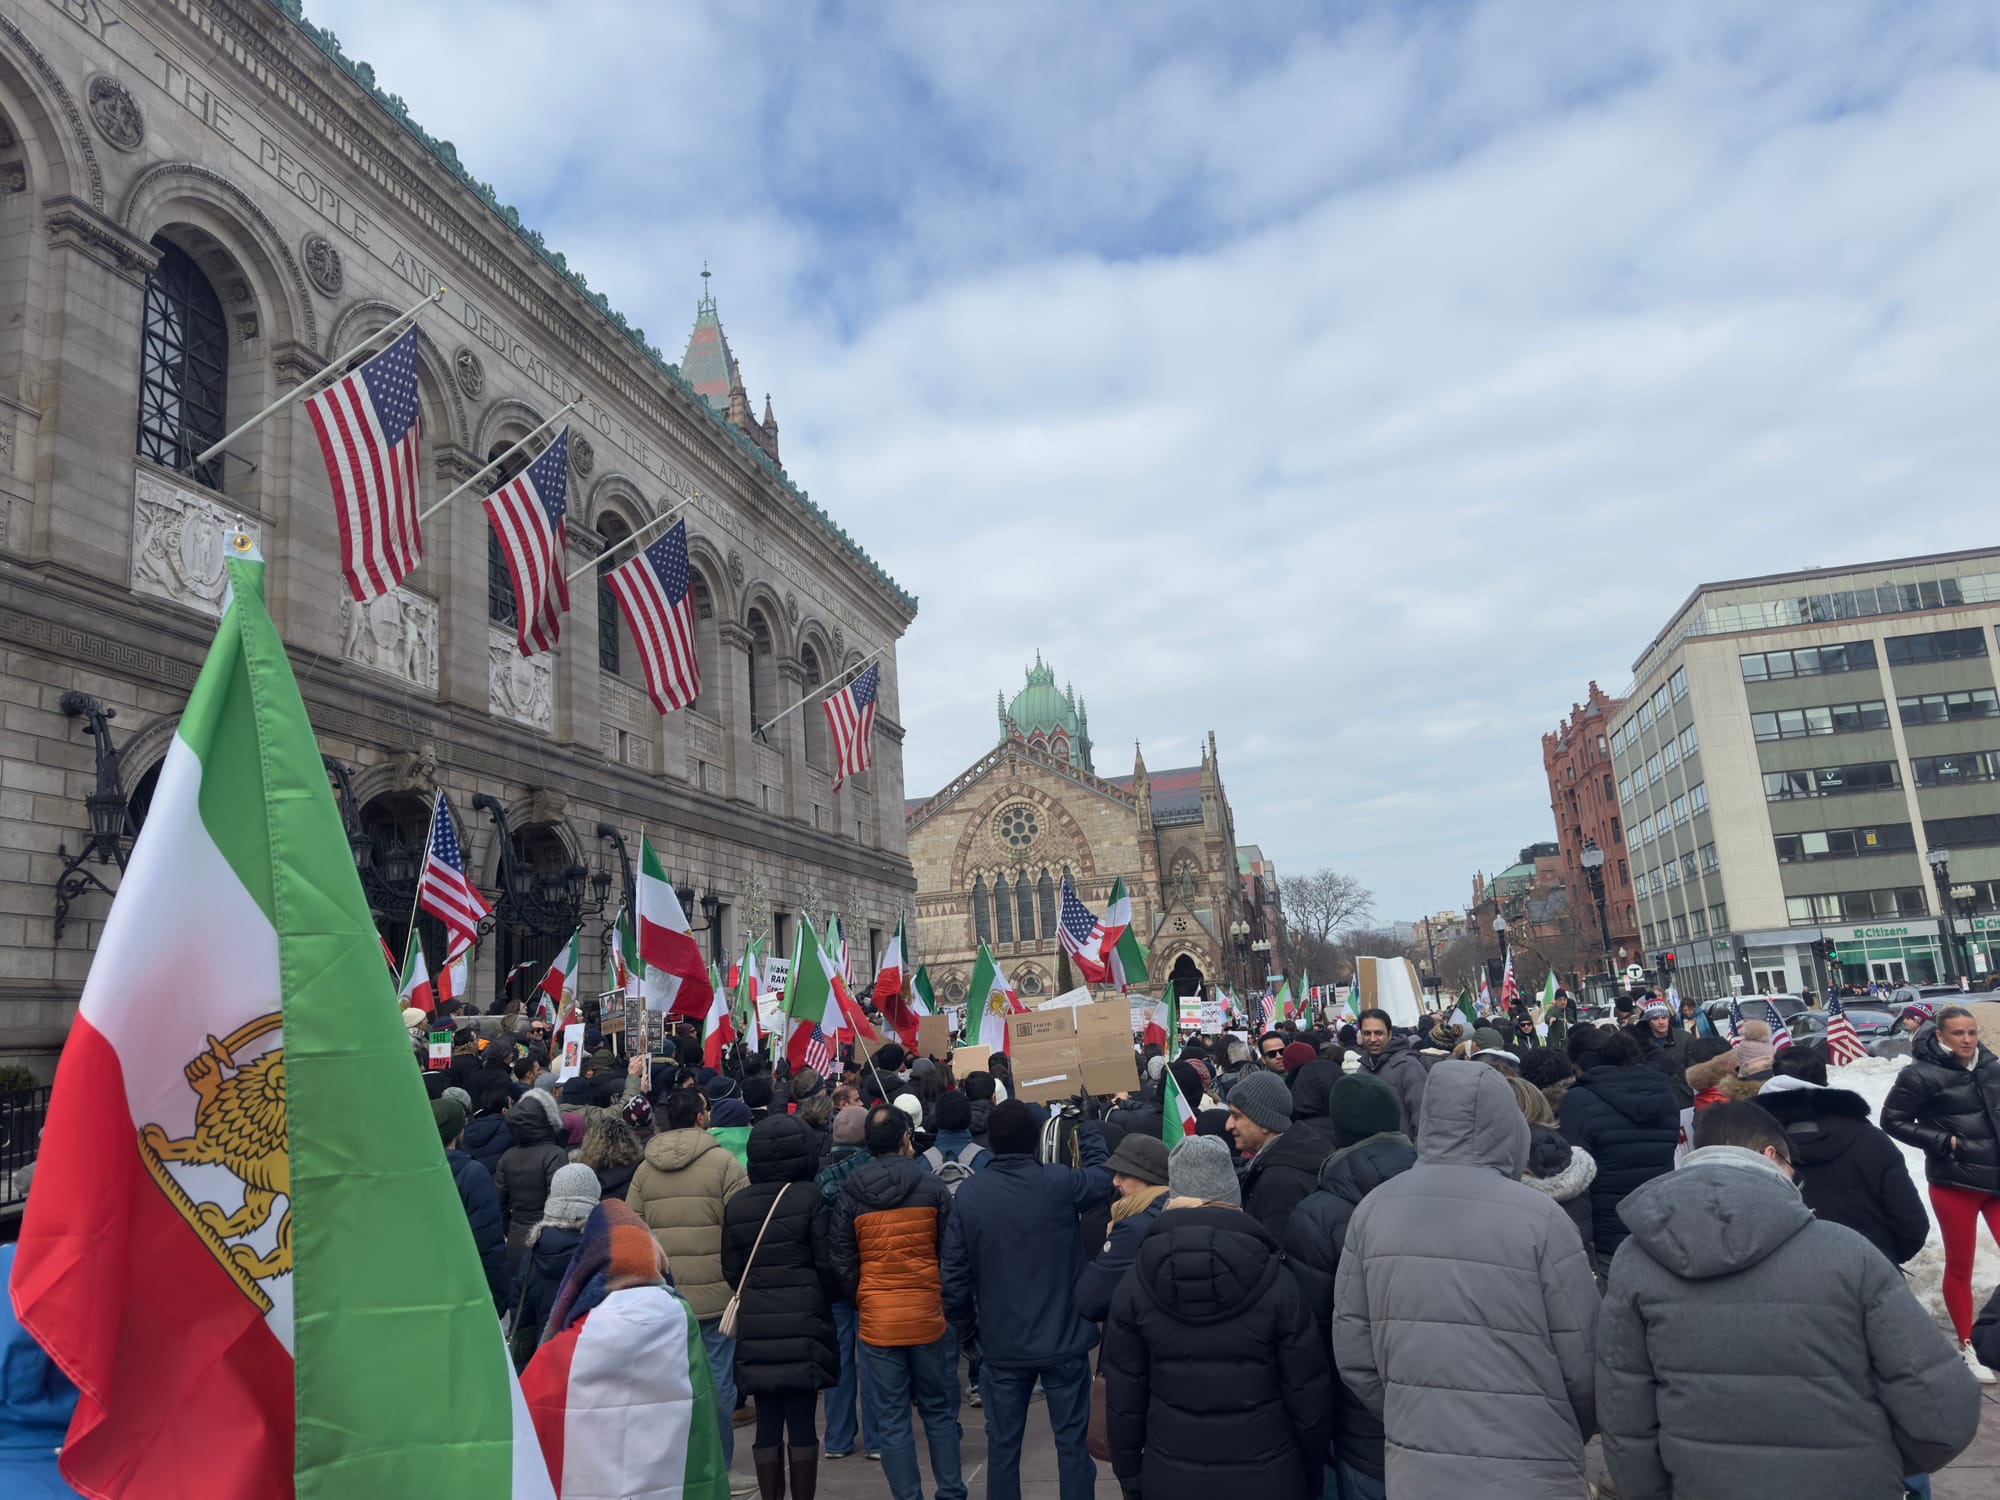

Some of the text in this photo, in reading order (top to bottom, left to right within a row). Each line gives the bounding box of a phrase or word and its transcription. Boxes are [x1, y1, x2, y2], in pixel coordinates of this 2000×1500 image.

[62, 0, 120, 39] BY
[154, 52, 235, 142] THE
[258, 137, 371, 249] PEOPLE
[391, 250, 442, 297] AND
[463, 302, 576, 406] DEDICATED
[589, 402, 612, 436] TO
[620, 427, 651, 469] THE
[753, 536, 767, 557] OF
[1865, 927, 1909, 938] Citizens
[770, 964, 789, 974] Make
[1629, 968, 1642, 977] T
